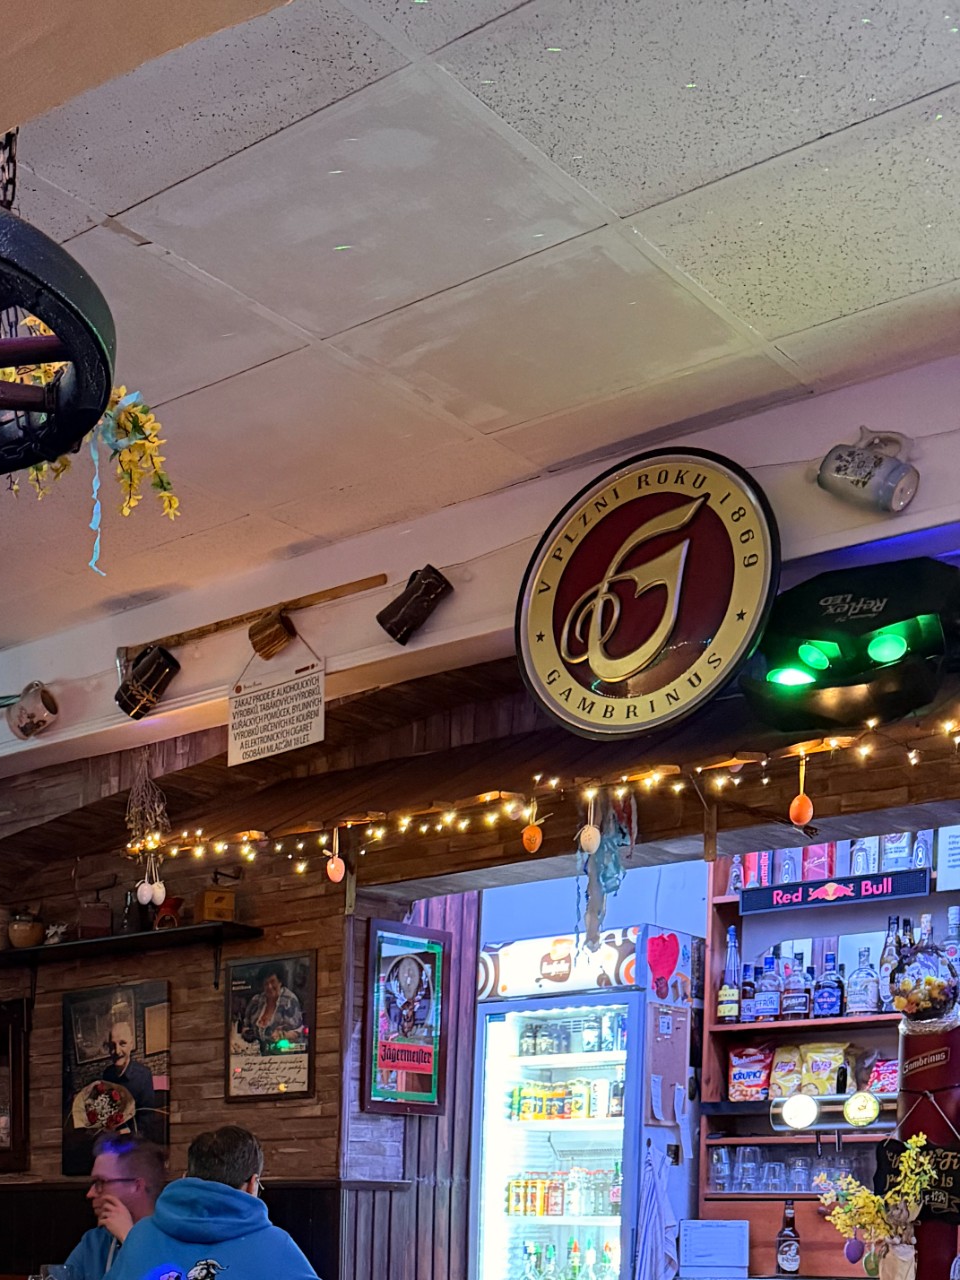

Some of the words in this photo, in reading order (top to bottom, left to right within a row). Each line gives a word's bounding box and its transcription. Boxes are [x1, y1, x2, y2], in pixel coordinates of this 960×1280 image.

[538, 581, 552, 595] V
[551, 487, 621, 563] PLZNI
[637, 469, 708, 491] ROKU
[719, 491, 759, 569] 1869
[234, 696, 252, 709] ZÁKAZ
[252, 690, 277, 705] PRODEJE
[277, 675, 319, 698] ALKOHOLICKÝCH
[545, 651, 723, 720] GAMBRINUS
[290, 721, 312, 736] CIGARET
[772, 887, 802, 906] Red
[861, 877, 892, 896] Bull
[380, 1044, 432, 1065] Jägermeister
[903, 1050, 947, 1075] Gambrinus
